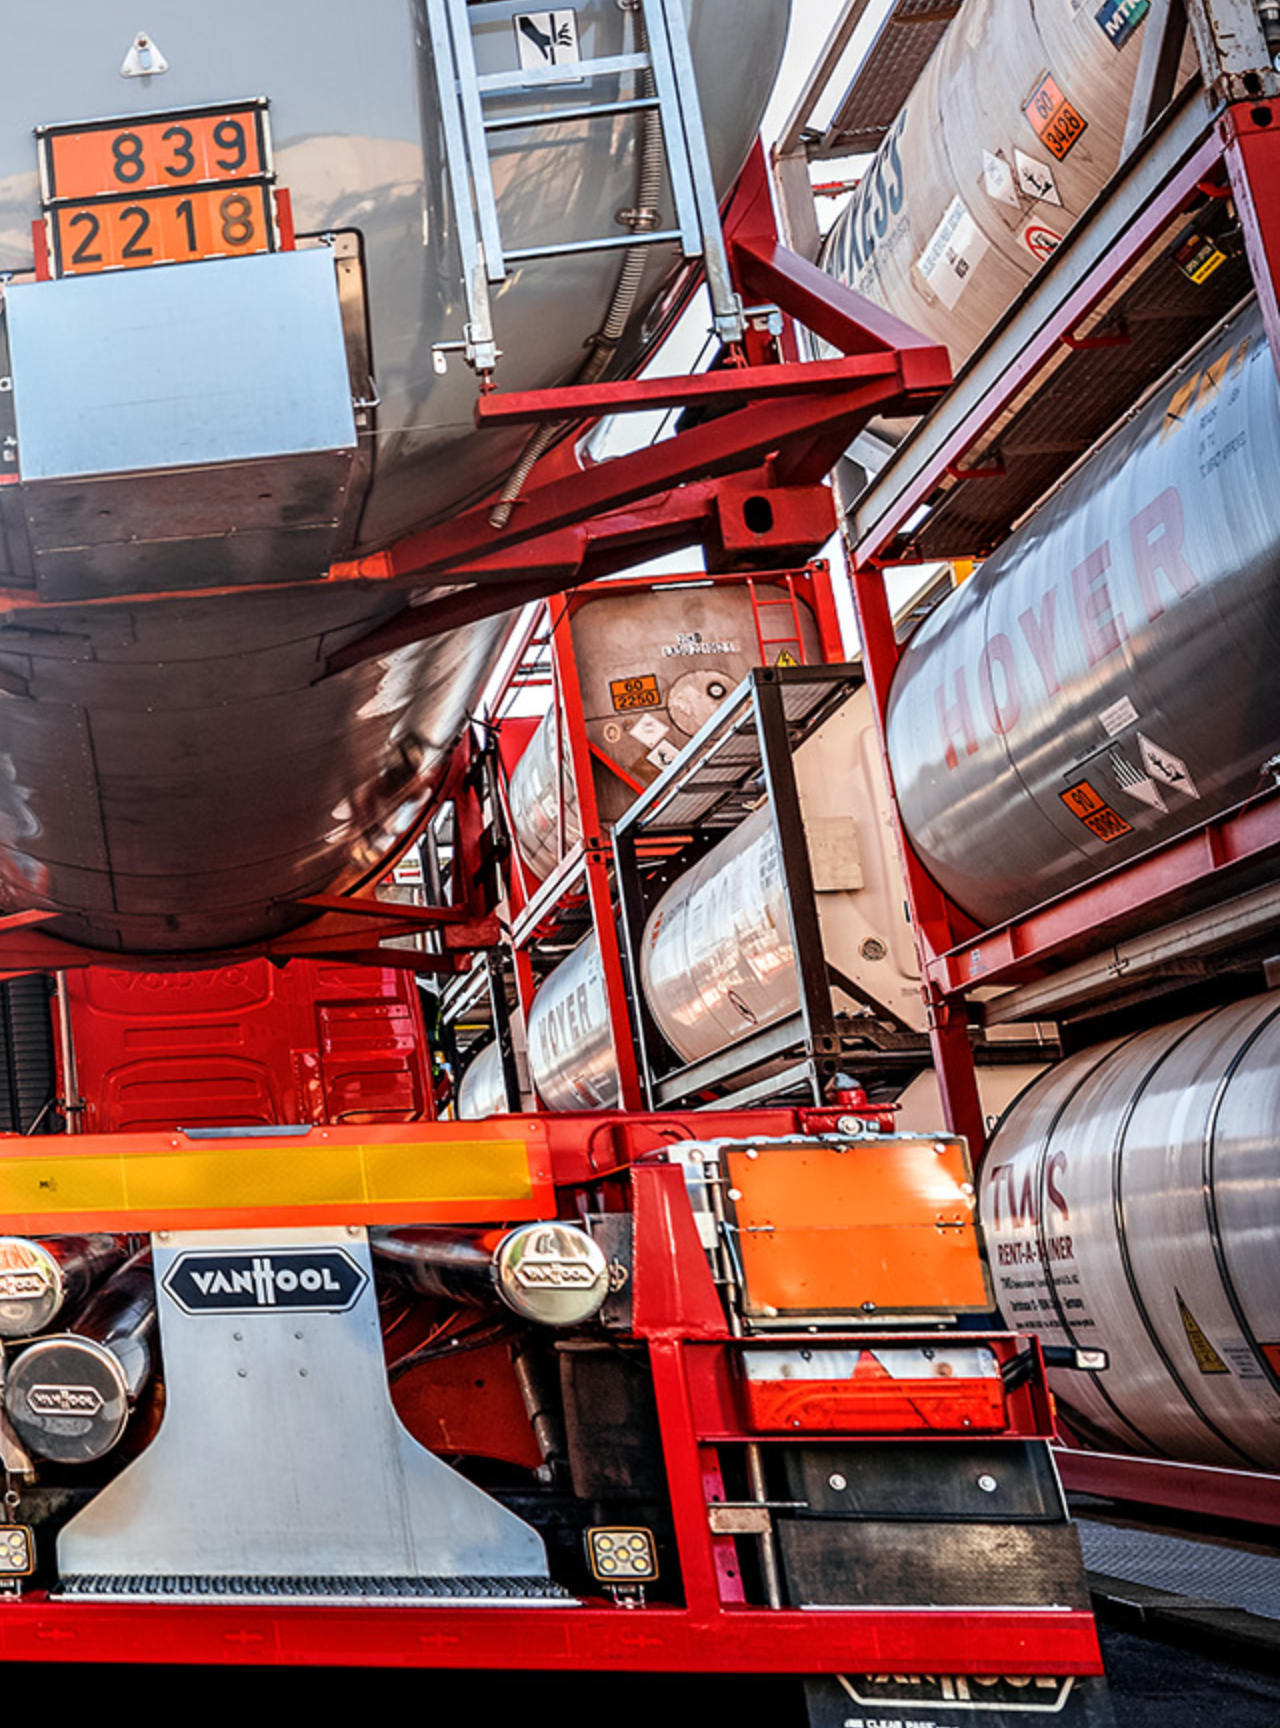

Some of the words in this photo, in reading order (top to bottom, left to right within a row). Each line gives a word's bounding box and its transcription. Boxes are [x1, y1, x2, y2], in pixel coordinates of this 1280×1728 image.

[1034, 90, 1055, 120] 60
[1045, 108, 1081, 153] 3428
[111, 120, 247, 184] 839
[68, 194, 255, 264] 2218
[934, 486, 1199, 771] HOYER
[537, 981, 594, 1062] HOYER
[990, 1151, 1069, 1232] TWS
